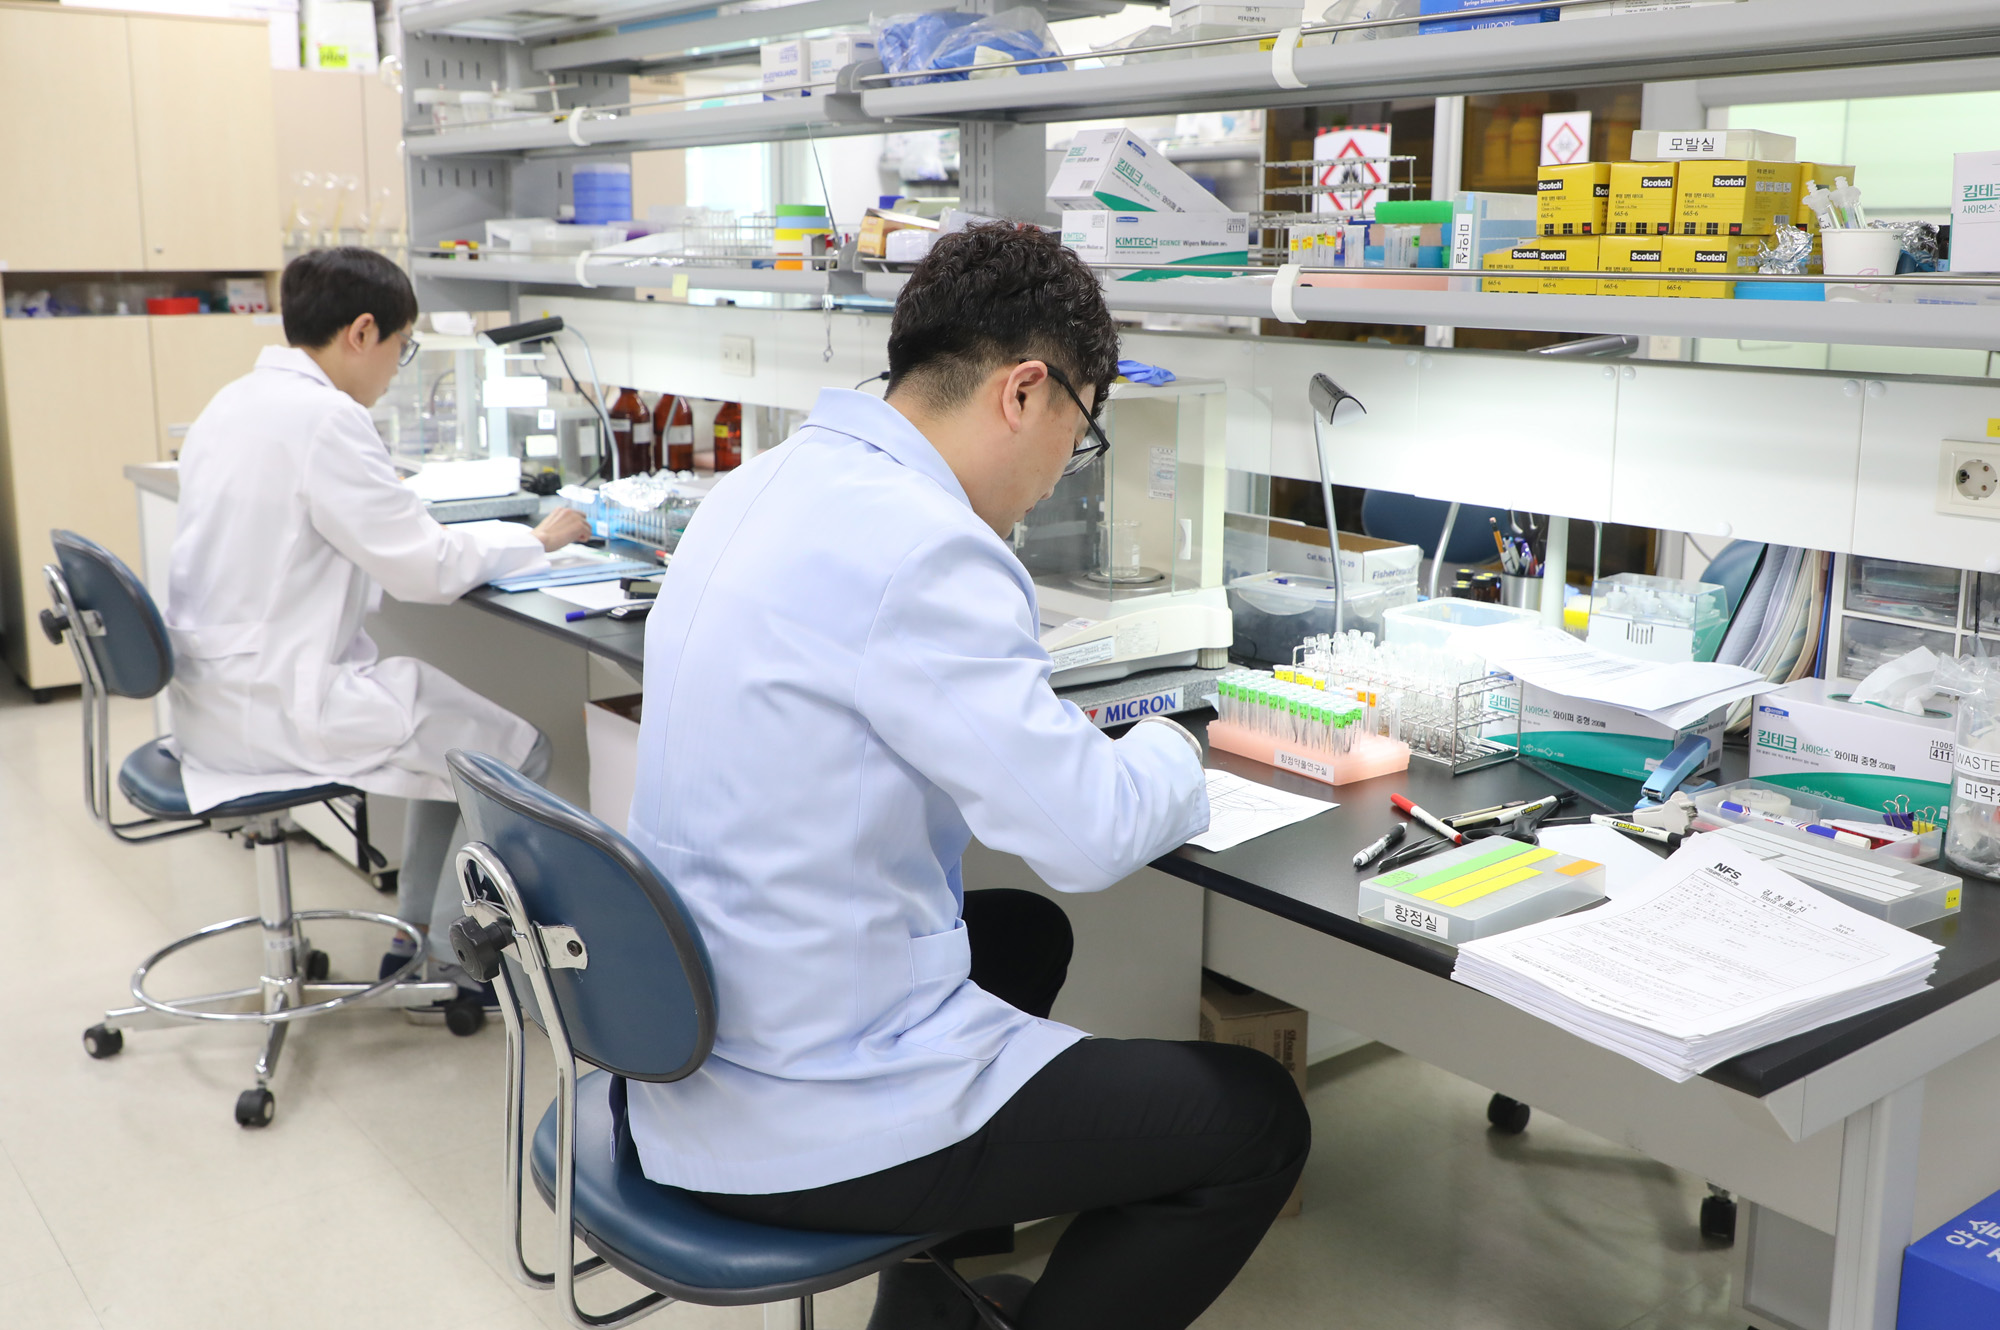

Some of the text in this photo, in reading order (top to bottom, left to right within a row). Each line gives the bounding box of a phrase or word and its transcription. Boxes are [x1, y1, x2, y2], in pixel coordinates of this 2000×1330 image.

[1669, 138, 1715, 152] 모발실
[1117, 157, 1143, 183] 킴테크
[1539, 181, 1562, 190] Scotch
[1643, 178, 1671, 187] Scotch
[1714, 178, 1744, 186] Scotch
[1596, 187, 1609, 196] Sco
[1962, 205, 1995, 214] 사이언스
[1228, 224, 1245, 232] 41117
[1116, 237, 1158, 246] KIMTECH
[1456, 224, 1469, 264] 마약실
[1541, 252, 1565, 260] Scotch
[1632, 252, 1659, 260] Scotch
[1696, 253, 1726, 261] Scotch
[1372, 566, 1415, 580] Fisherbrand
[1105, 693, 1176, 723] MICRON
[1525, 705, 1550, 717] 사이언스
[1553, 710, 1574, 722] 와이퍼
[1577, 715, 1590, 726] 중형
[1758, 729, 1797, 750] 킴테크
[1800, 743, 1831, 756] 사이언스
[1834, 750, 1858, 763] 와이퍼
[1861, 756, 1877, 767] 중형
[1879, 762, 1896, 771] 200매
[1932, 749, 1953, 761] 411
[1958, 753, 2000, 772] WASTE
[1714, 863, 1742, 879] NFS
[1395, 905, 1437, 932] 향정실
